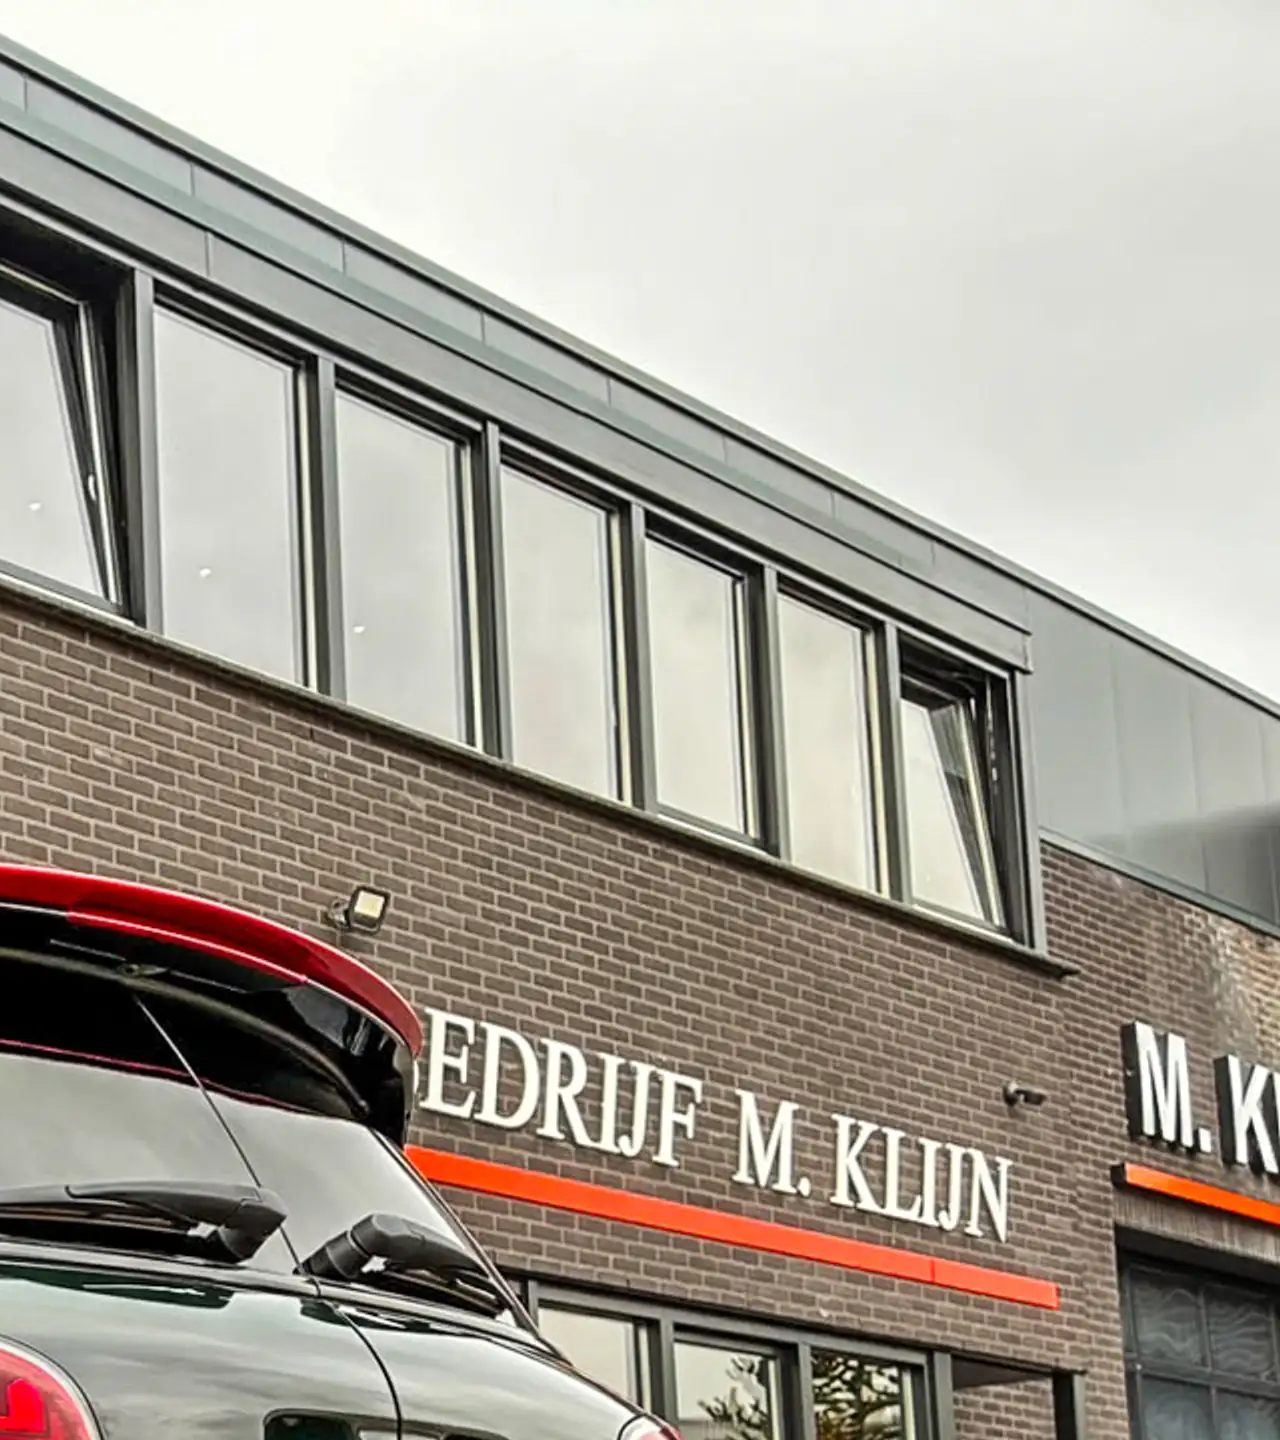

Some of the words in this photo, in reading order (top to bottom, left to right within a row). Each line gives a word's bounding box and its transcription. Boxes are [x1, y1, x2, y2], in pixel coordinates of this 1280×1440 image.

[413, 1008, 702, 1168] EDRIJF
[732, 1088, 810, 1197] M.
[829, 1113, 1013, 1243] KLIJN
[1130, 1020, 1211, 1153] M.
[1224, 1054, 1280, 1174] K
